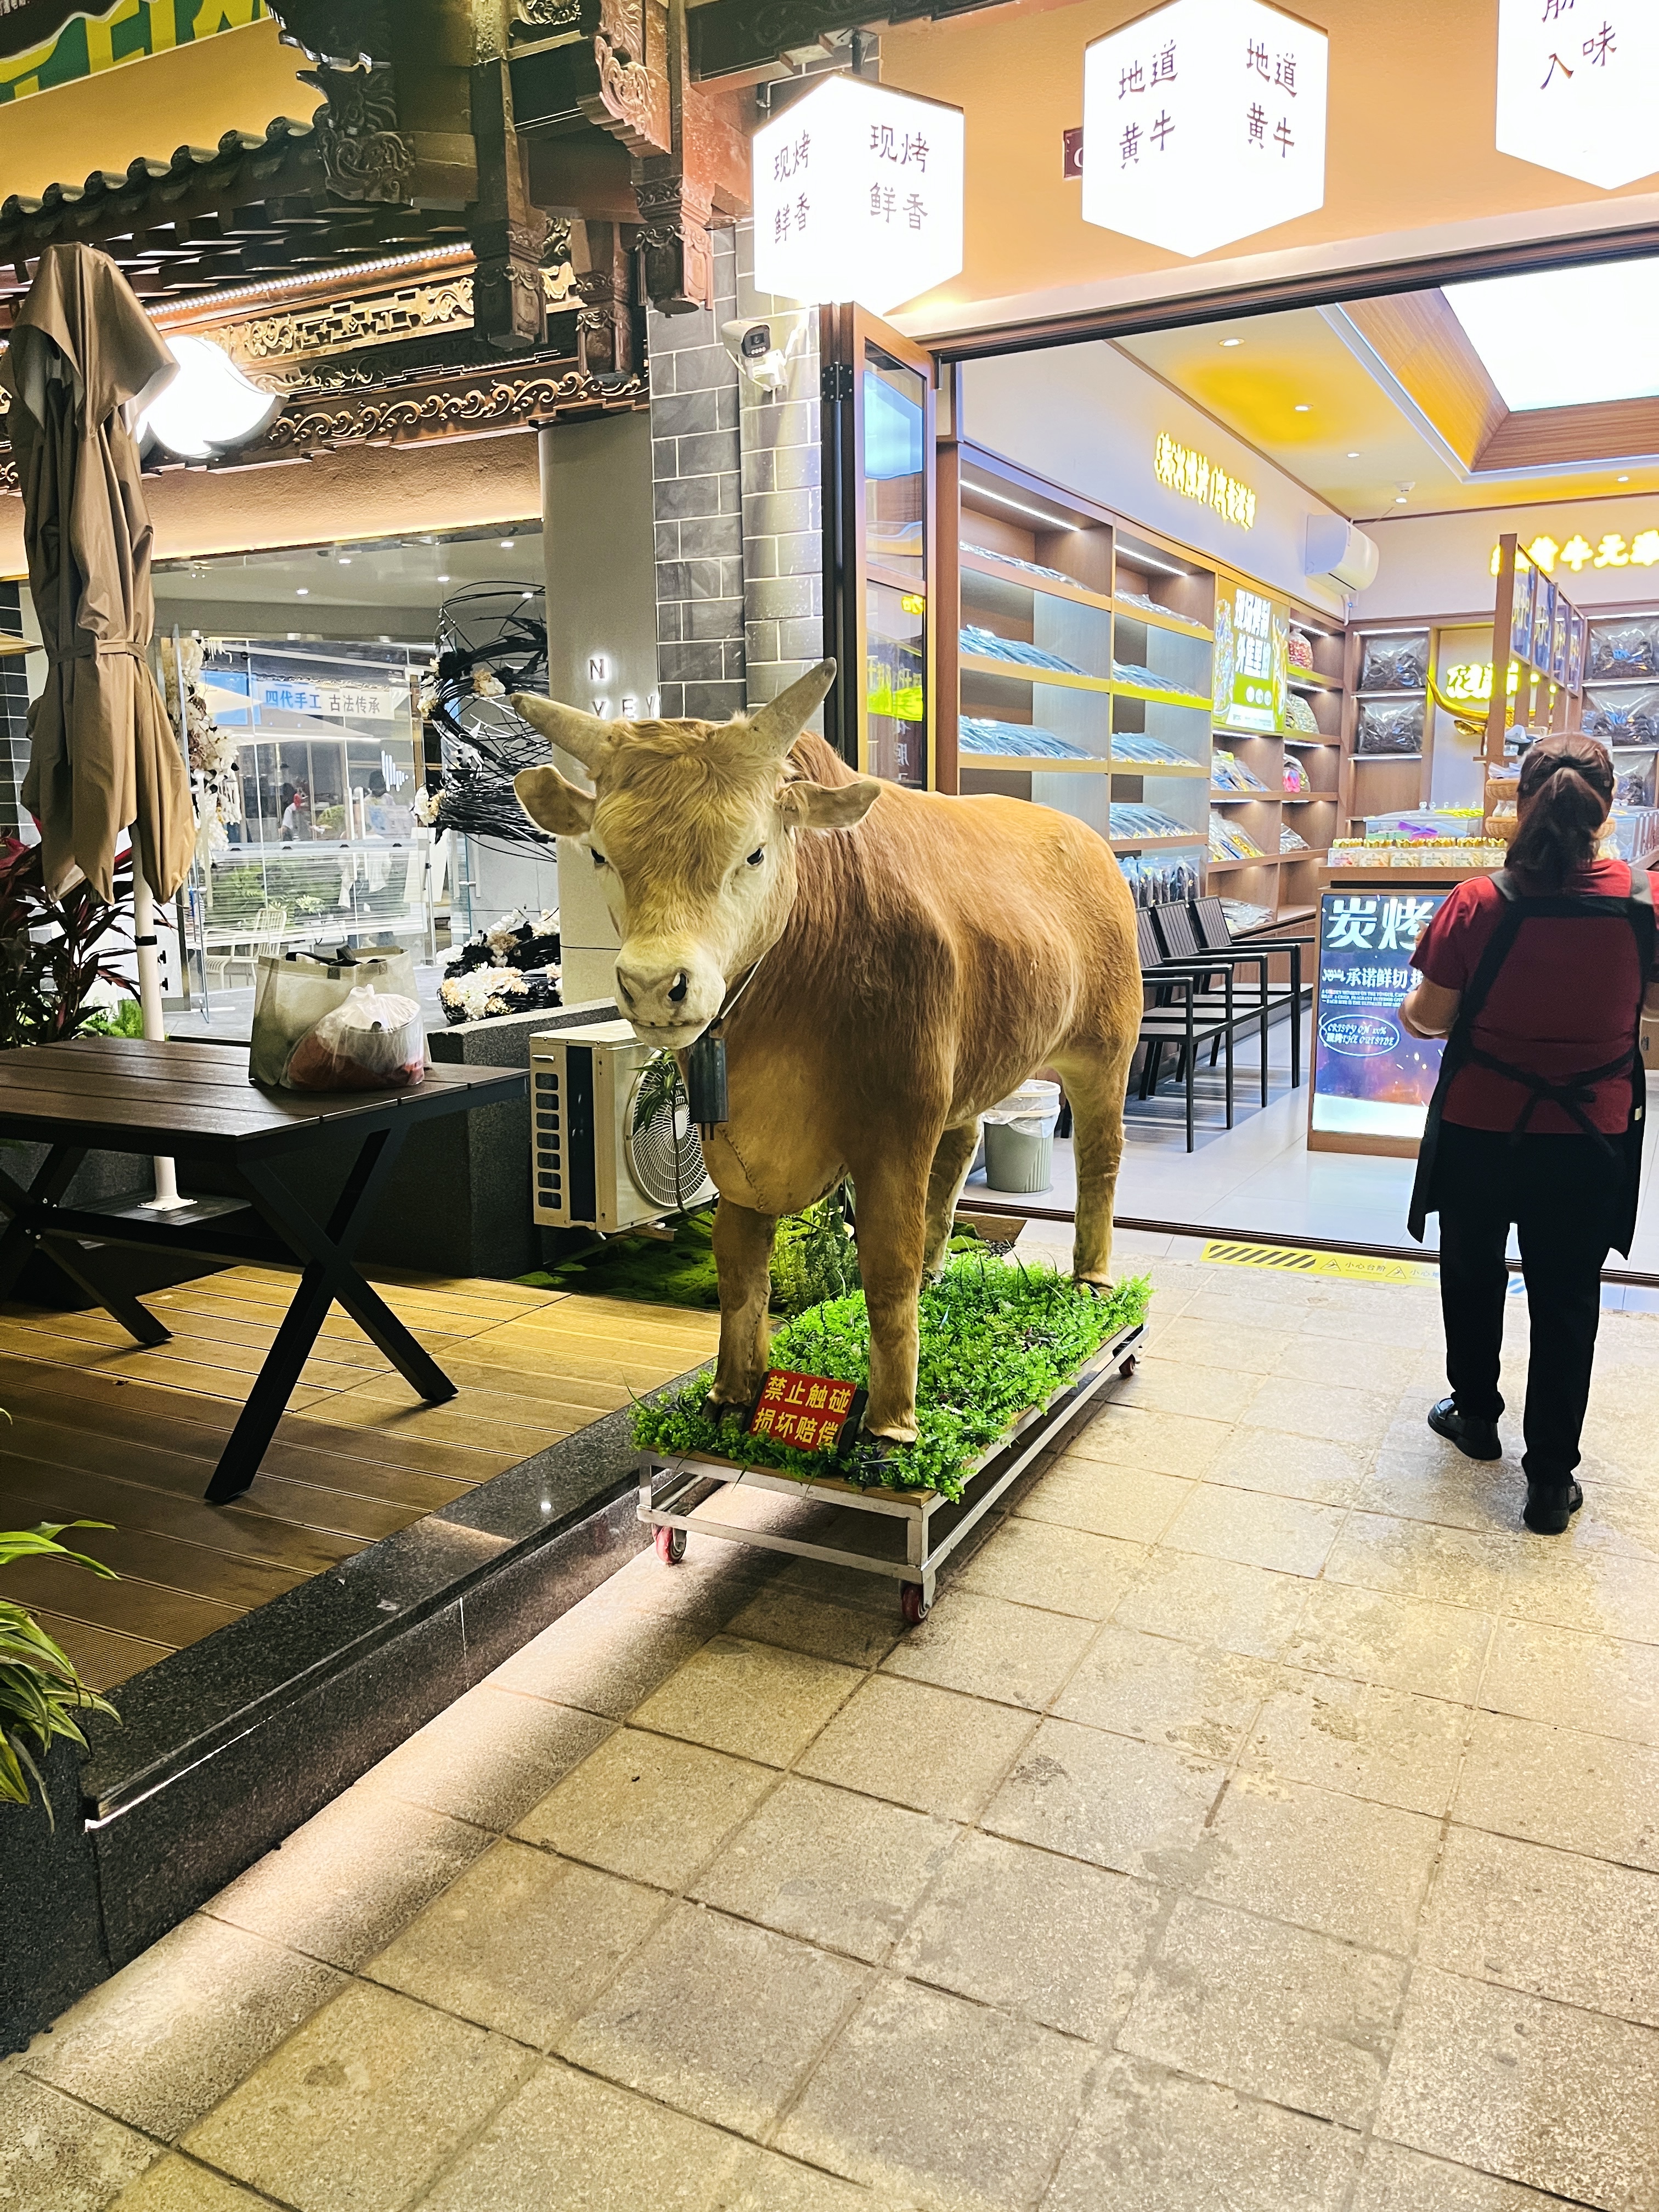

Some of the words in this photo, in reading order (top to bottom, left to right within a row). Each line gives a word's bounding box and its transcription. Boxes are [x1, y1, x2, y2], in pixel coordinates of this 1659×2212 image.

[1119, 39, 1178, 100] 地道
[1246, 38, 1297, 98] 地道
[1540, 21, 1617, 89] 入味
[870, 125, 930, 173] 现烤
[1119, 109, 1176, 170] 黄牛
[1246, 102, 1295, 158] 黄牛
[774, 129, 811, 182] 现烤
[775, 192, 810, 244] 鲜香
[870, 182, 928, 230] 鲜香
[266, 690, 321, 710] 四代手工
[329, 693, 380, 714] 古法传承
[1326, 898, 1434, 951] 炭烤
[1346, 967, 1408, 989] 承诺鲜切
[1327, 1023, 1357, 1035] CRISPY
[1357, 1024, 1373, 1035] ON
[1359, 1036, 1395, 1046] OUTSIDE
[1345, 1261, 1386, 1272] 小心台阶
[764, 1375, 851, 1414] 禁止触碰
[752, 1407, 839, 1447] 损坏赔偿
